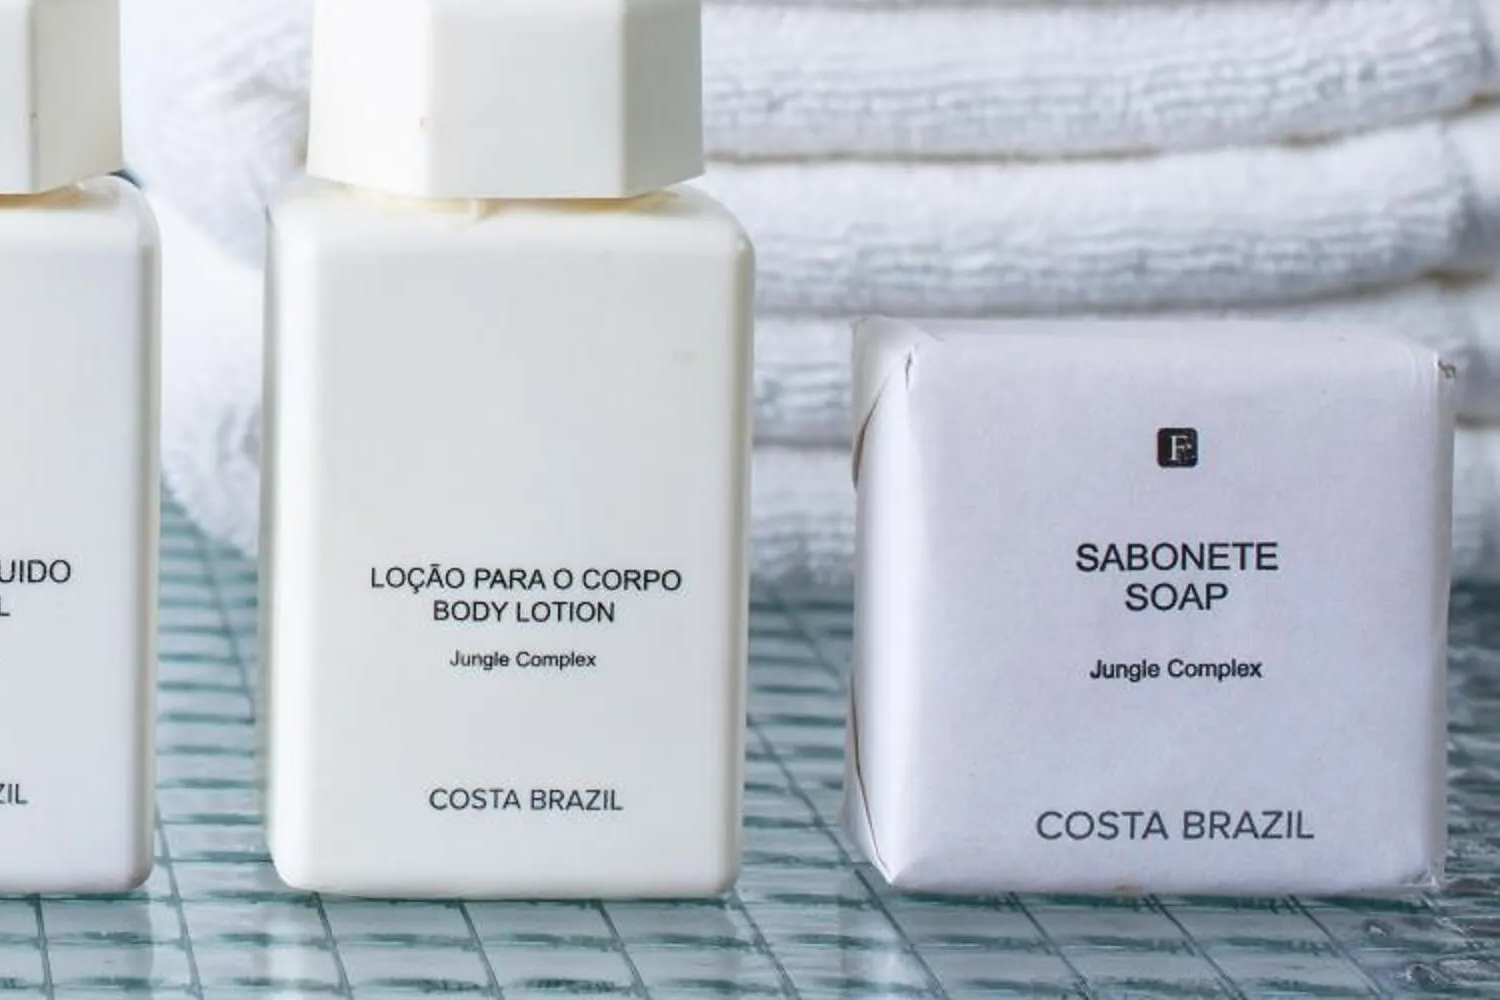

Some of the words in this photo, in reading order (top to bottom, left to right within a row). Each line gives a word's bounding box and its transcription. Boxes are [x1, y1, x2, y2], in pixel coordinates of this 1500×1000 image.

[1076, 542, 1279, 572] SABONETE
[371, 562, 465, 594] LOÇÃO
[474, 568, 546, 590] PARA
[553, 568, 573, 590] O
[582, 568, 682, 591] CORPO
[1125, 582, 1228, 612] SOAP
[434, 600, 508, 622] BODY
[516, 601, 615, 623] LOTION
[450, 649, 511, 671] Jungle
[516, 650, 597, 672] Complex
[1090, 658, 1160, 684] Jungle
[1167, 657, 1263, 683] Complex
[429, 787, 521, 811] COSTA
[530, 788, 623, 812] BRAZIL
[1036, 810, 1169, 840] COSTA
[1183, 809, 1315, 840] BRAZIL
